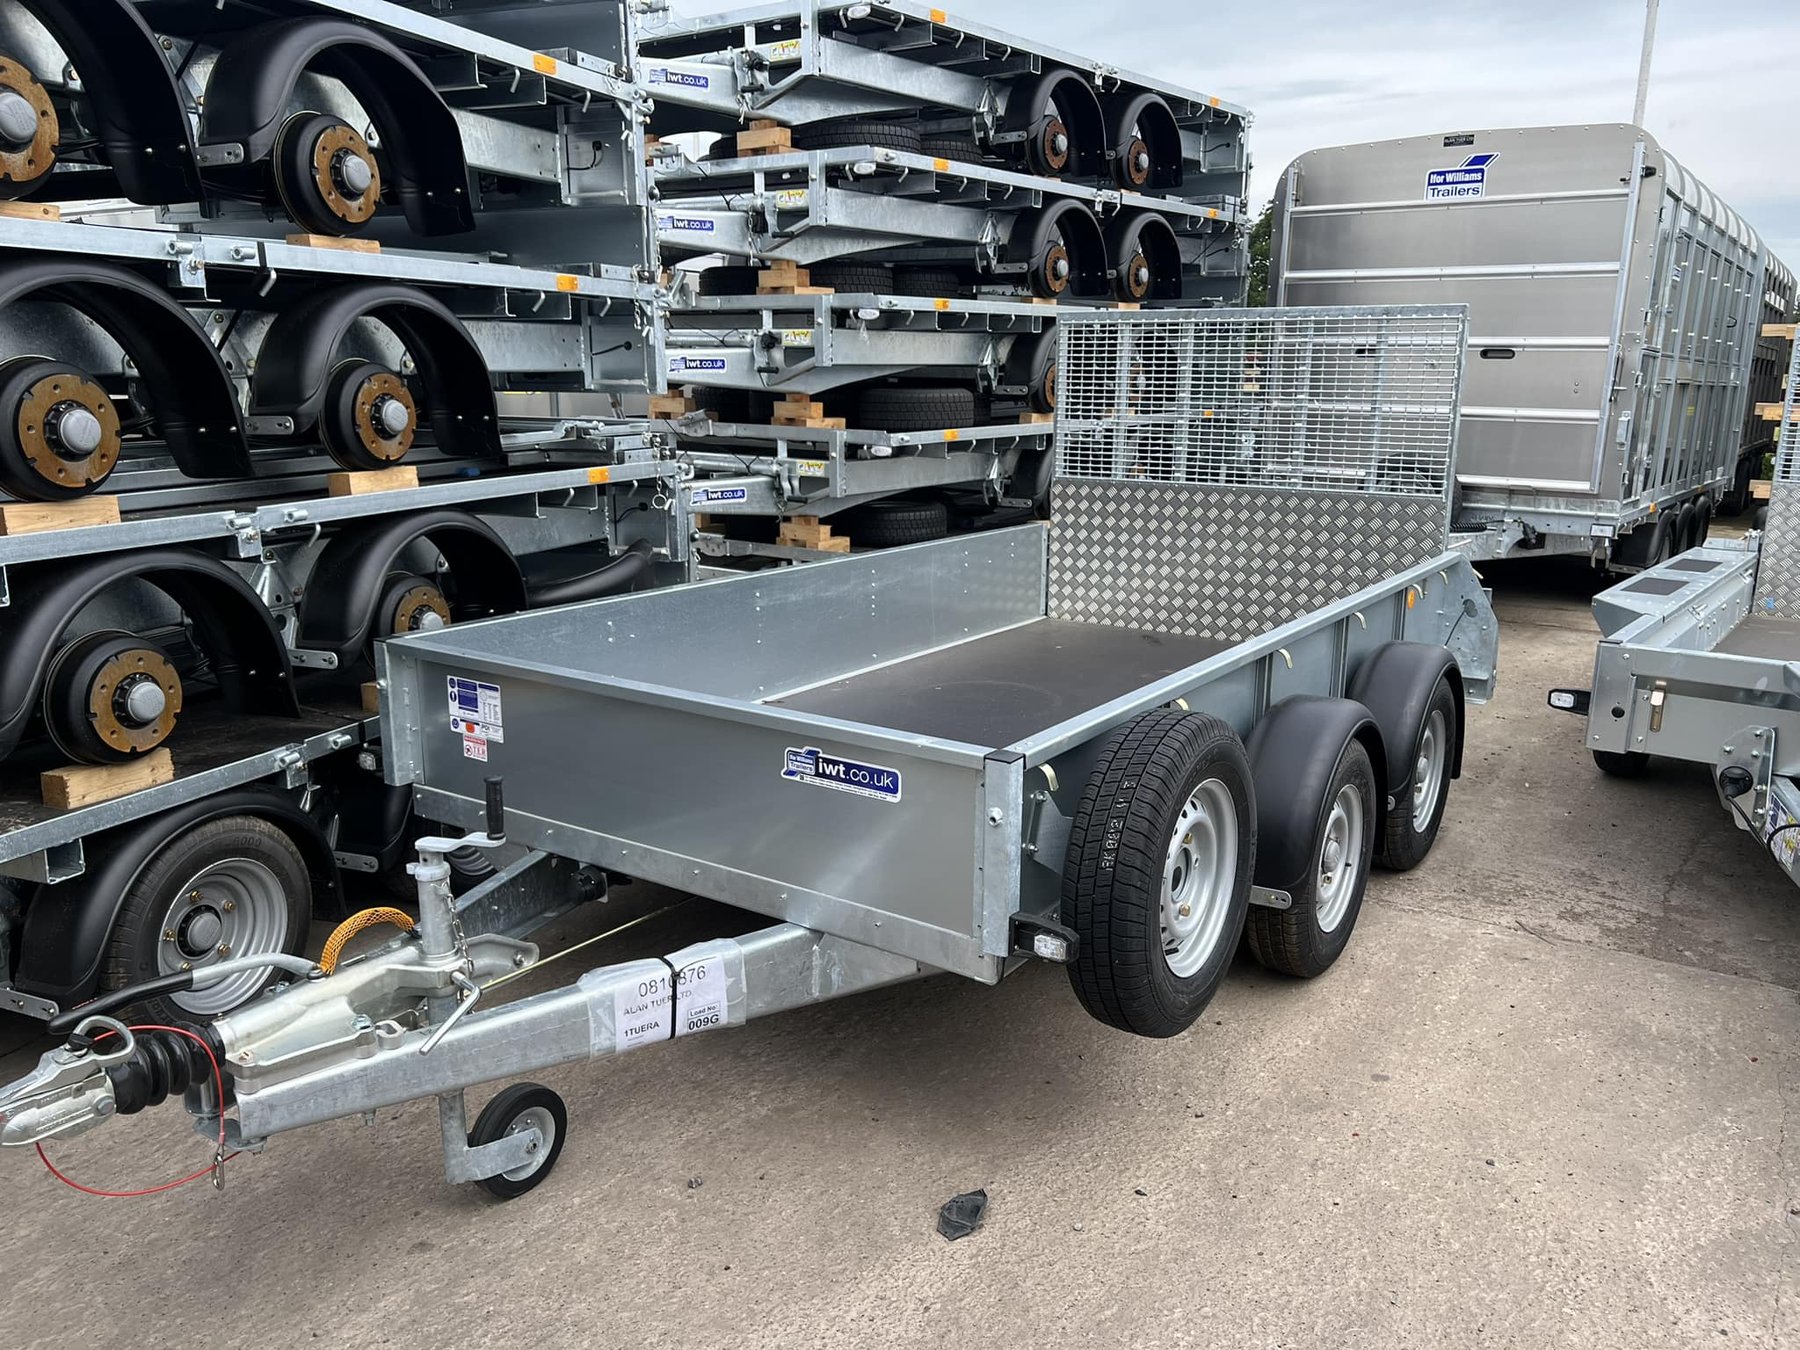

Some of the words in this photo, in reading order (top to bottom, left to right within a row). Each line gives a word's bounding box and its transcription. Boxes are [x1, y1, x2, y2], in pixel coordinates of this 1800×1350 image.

[1429, 173, 1445, 184] Ifor
[1445, 171, 1482, 183] Williams
[1429, 186, 1480, 198] Trailers
[818, 758, 894, 789] iwt.co.uk
[624, 1002, 649, 1016] ALAN
[689, 1007, 706, 1018] Load
[624, 1021, 660, 1038] 1TUERA
[688, 1014, 720, 1031] 009G
